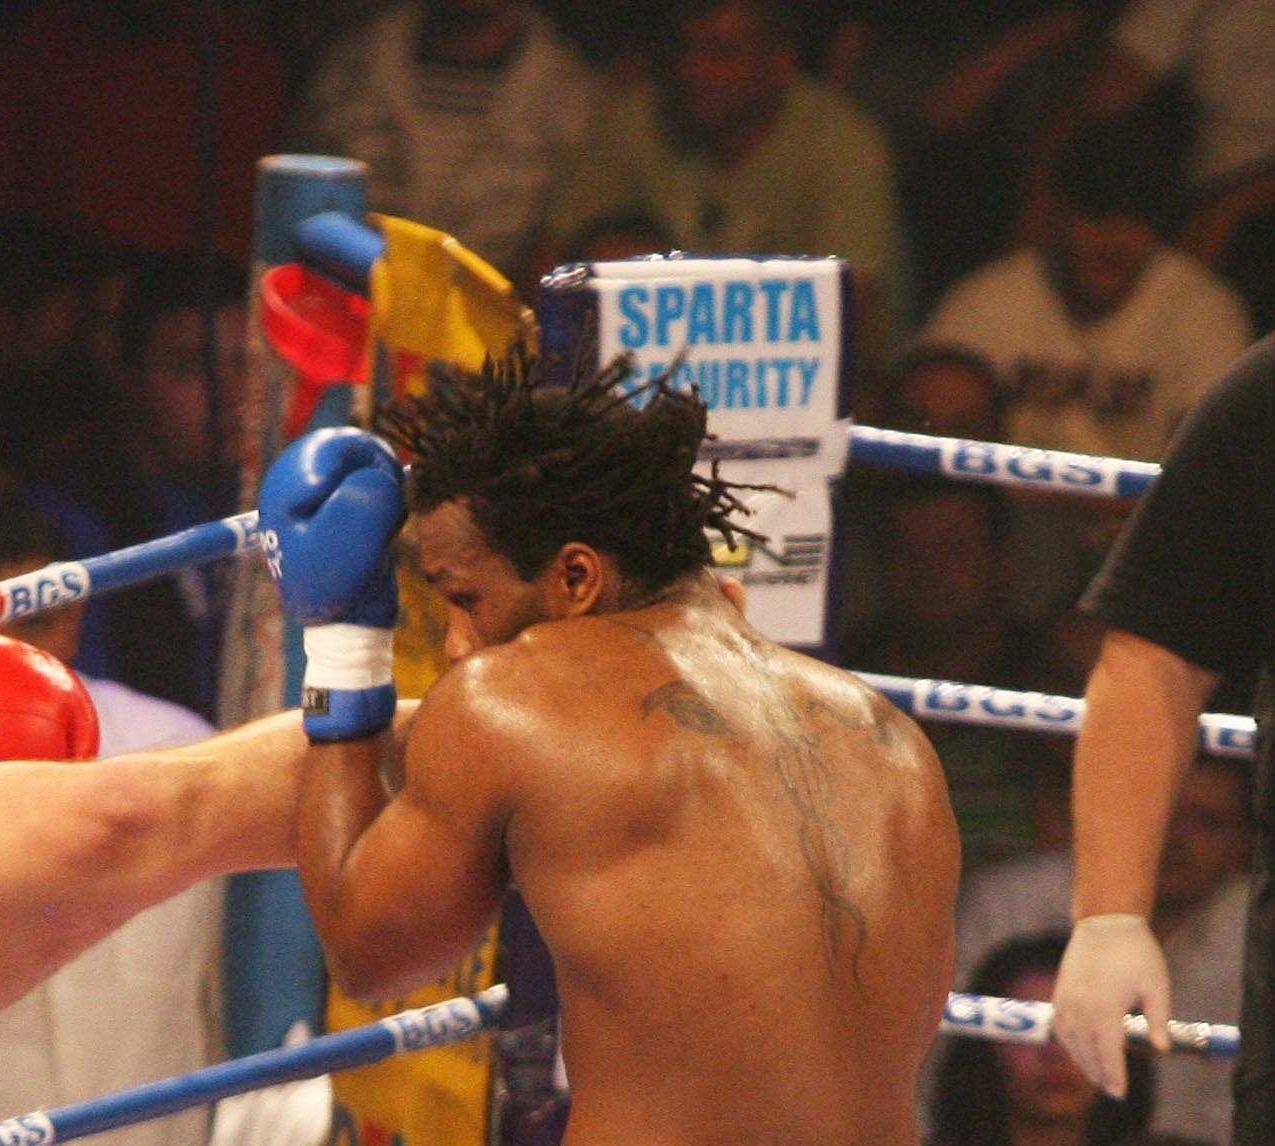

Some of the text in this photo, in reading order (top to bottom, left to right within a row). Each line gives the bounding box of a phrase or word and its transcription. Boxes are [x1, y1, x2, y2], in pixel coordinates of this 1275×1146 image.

[617, 278, 822, 348] SPARTA
[953, 443, 1104, 488] BGS
[9, 570, 83, 619] BGS
